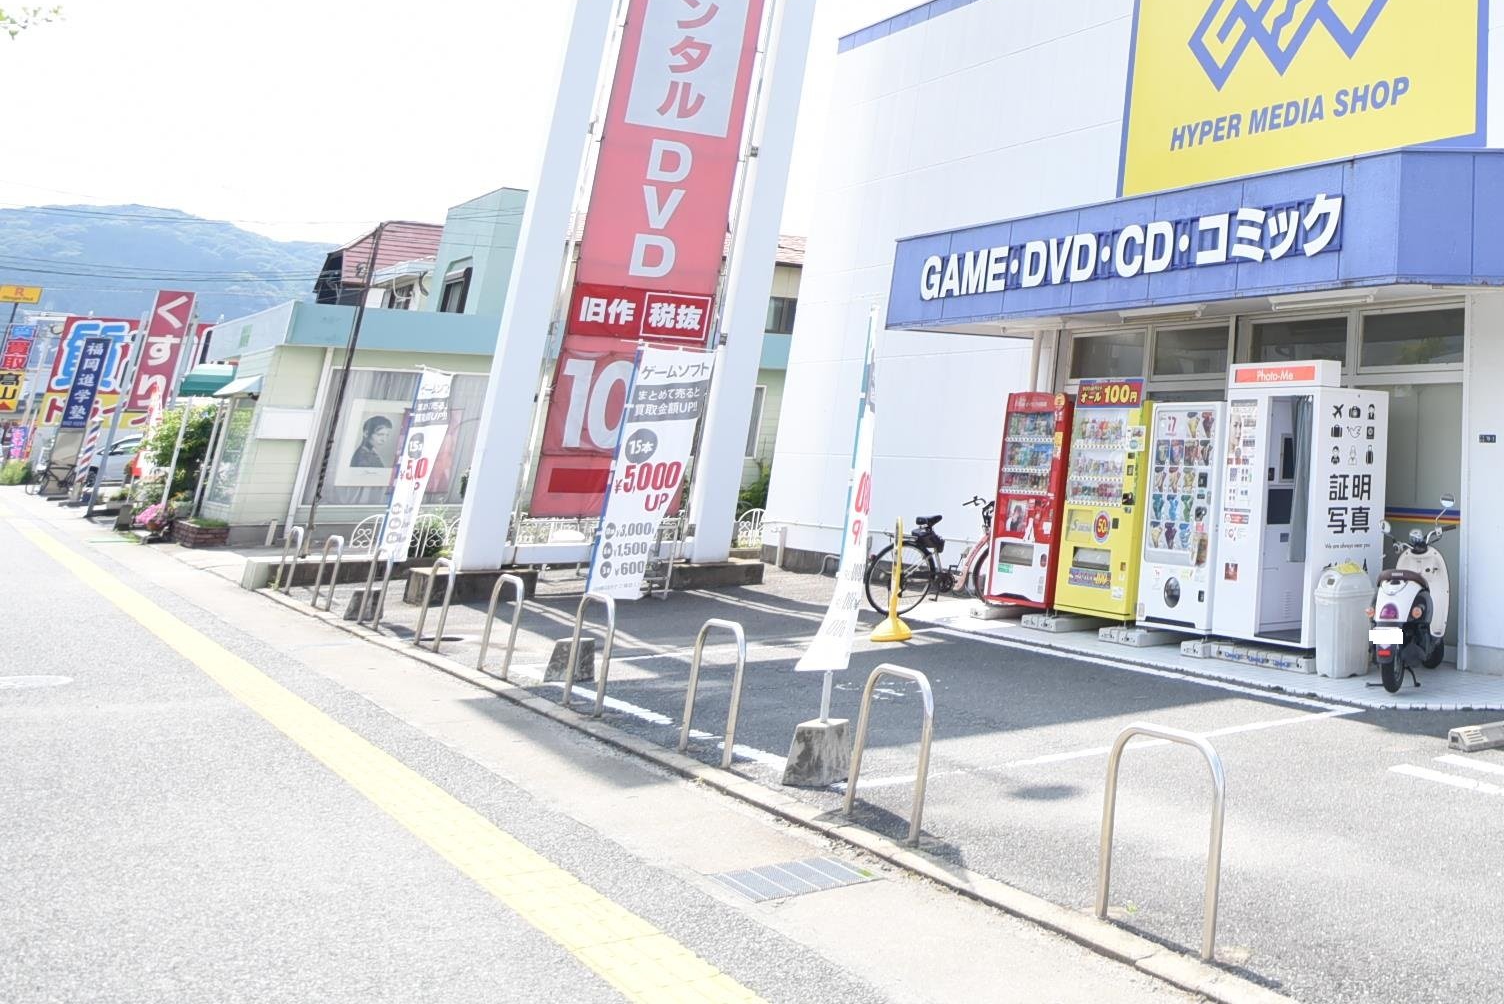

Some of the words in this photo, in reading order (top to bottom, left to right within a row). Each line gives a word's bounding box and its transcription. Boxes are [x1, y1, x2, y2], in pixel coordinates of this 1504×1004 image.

[1169, 113, 1243, 152] HYPER
[1247, 94, 1325, 136] MEDIA
[1332, 76, 1410, 118] SHOP
[628, 138, 693, 278] DVD
[579, 296, 636, 326] 旧作
[648, 302, 703, 330] 税抜
[138, 295, 189, 407] くすり
[68, 342, 104, 420] 福岡進学塾
[641, 362, 709, 380] ゲームソフト
[1256, 370, 1294, 381] Photo-Me
[1080, 391, 1102, 403] オール
[1104, 384, 1138, 403] 100円
[614, 460, 682, 494] ¥5,000
[1328, 473, 1372, 501] 証明
[645, 492, 670, 512] UP
[1327, 506, 1371, 534] 写真
